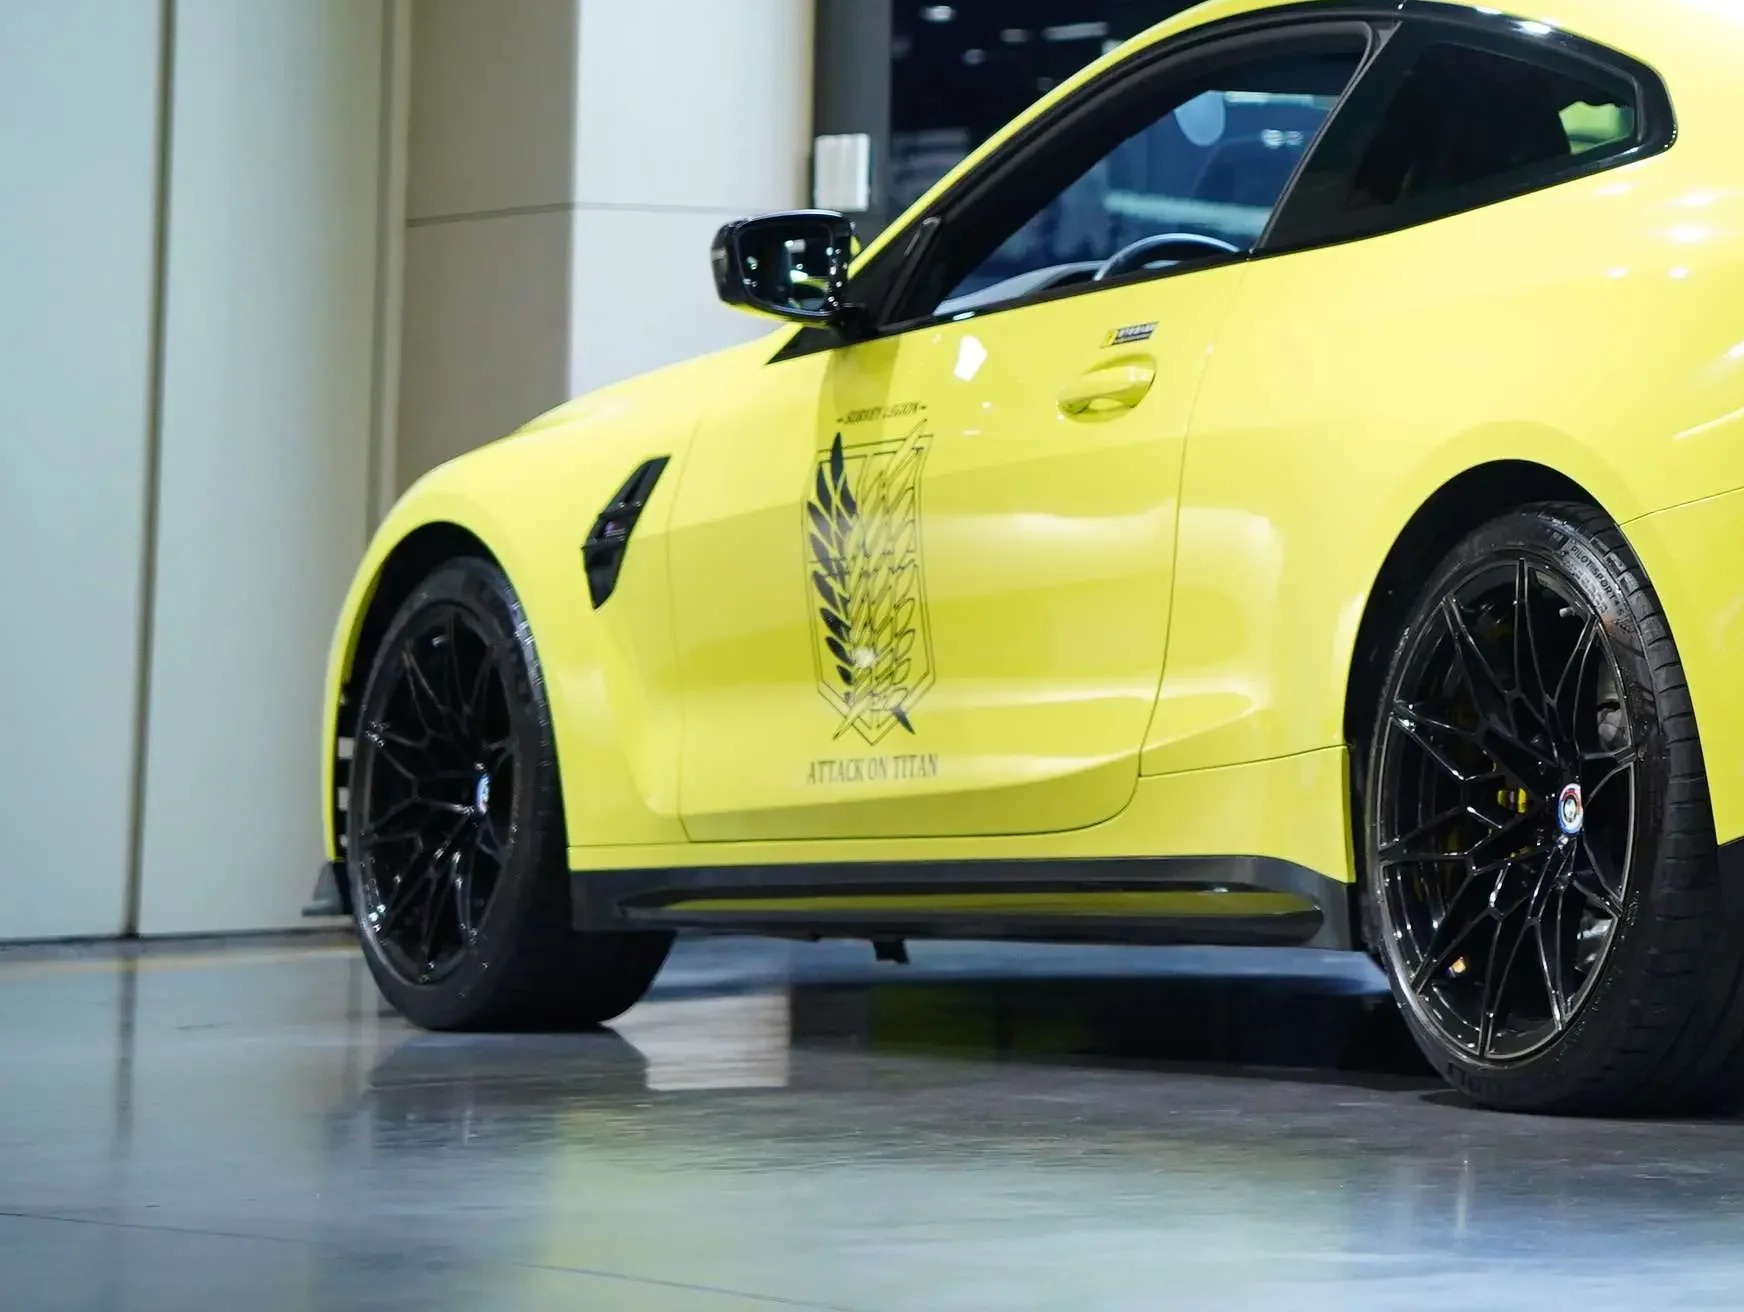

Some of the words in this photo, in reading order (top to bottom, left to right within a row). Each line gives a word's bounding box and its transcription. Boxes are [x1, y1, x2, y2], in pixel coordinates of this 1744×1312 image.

[807, 758, 865, 785] ATTACK
[868, 756, 888, 781] ON
[893, 753, 939, 780] TITAN
